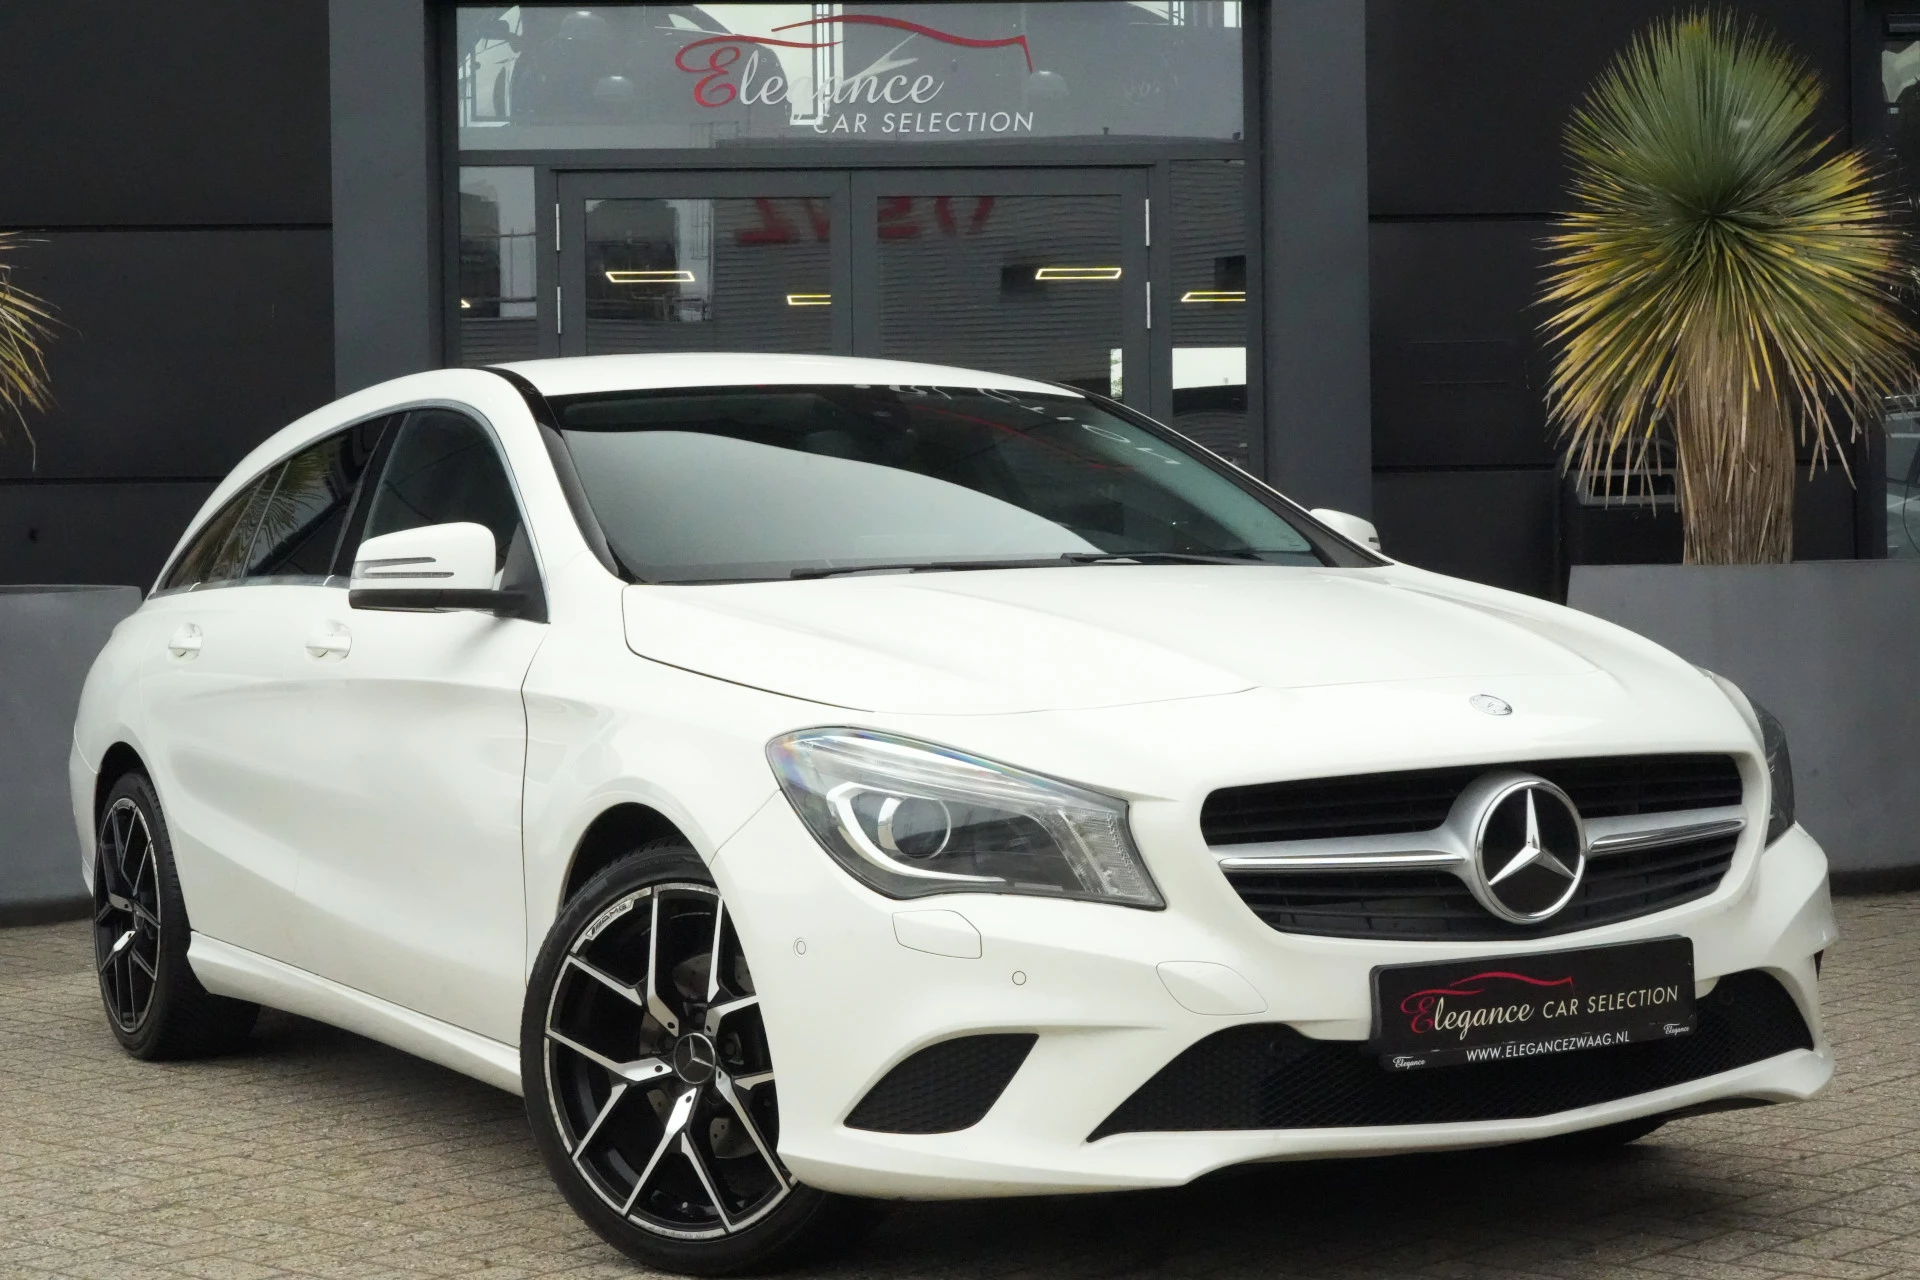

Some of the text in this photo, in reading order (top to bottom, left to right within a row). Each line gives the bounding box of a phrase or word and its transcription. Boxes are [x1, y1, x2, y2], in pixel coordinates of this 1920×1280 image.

[813, 111, 1034, 134] CAR SELECTION
[1401, 985, 1679, 1041] Elegance CAR SELECTION
[1466, 1031, 1630, 1062] WWW.ELEGANCEZWAAG.NL
